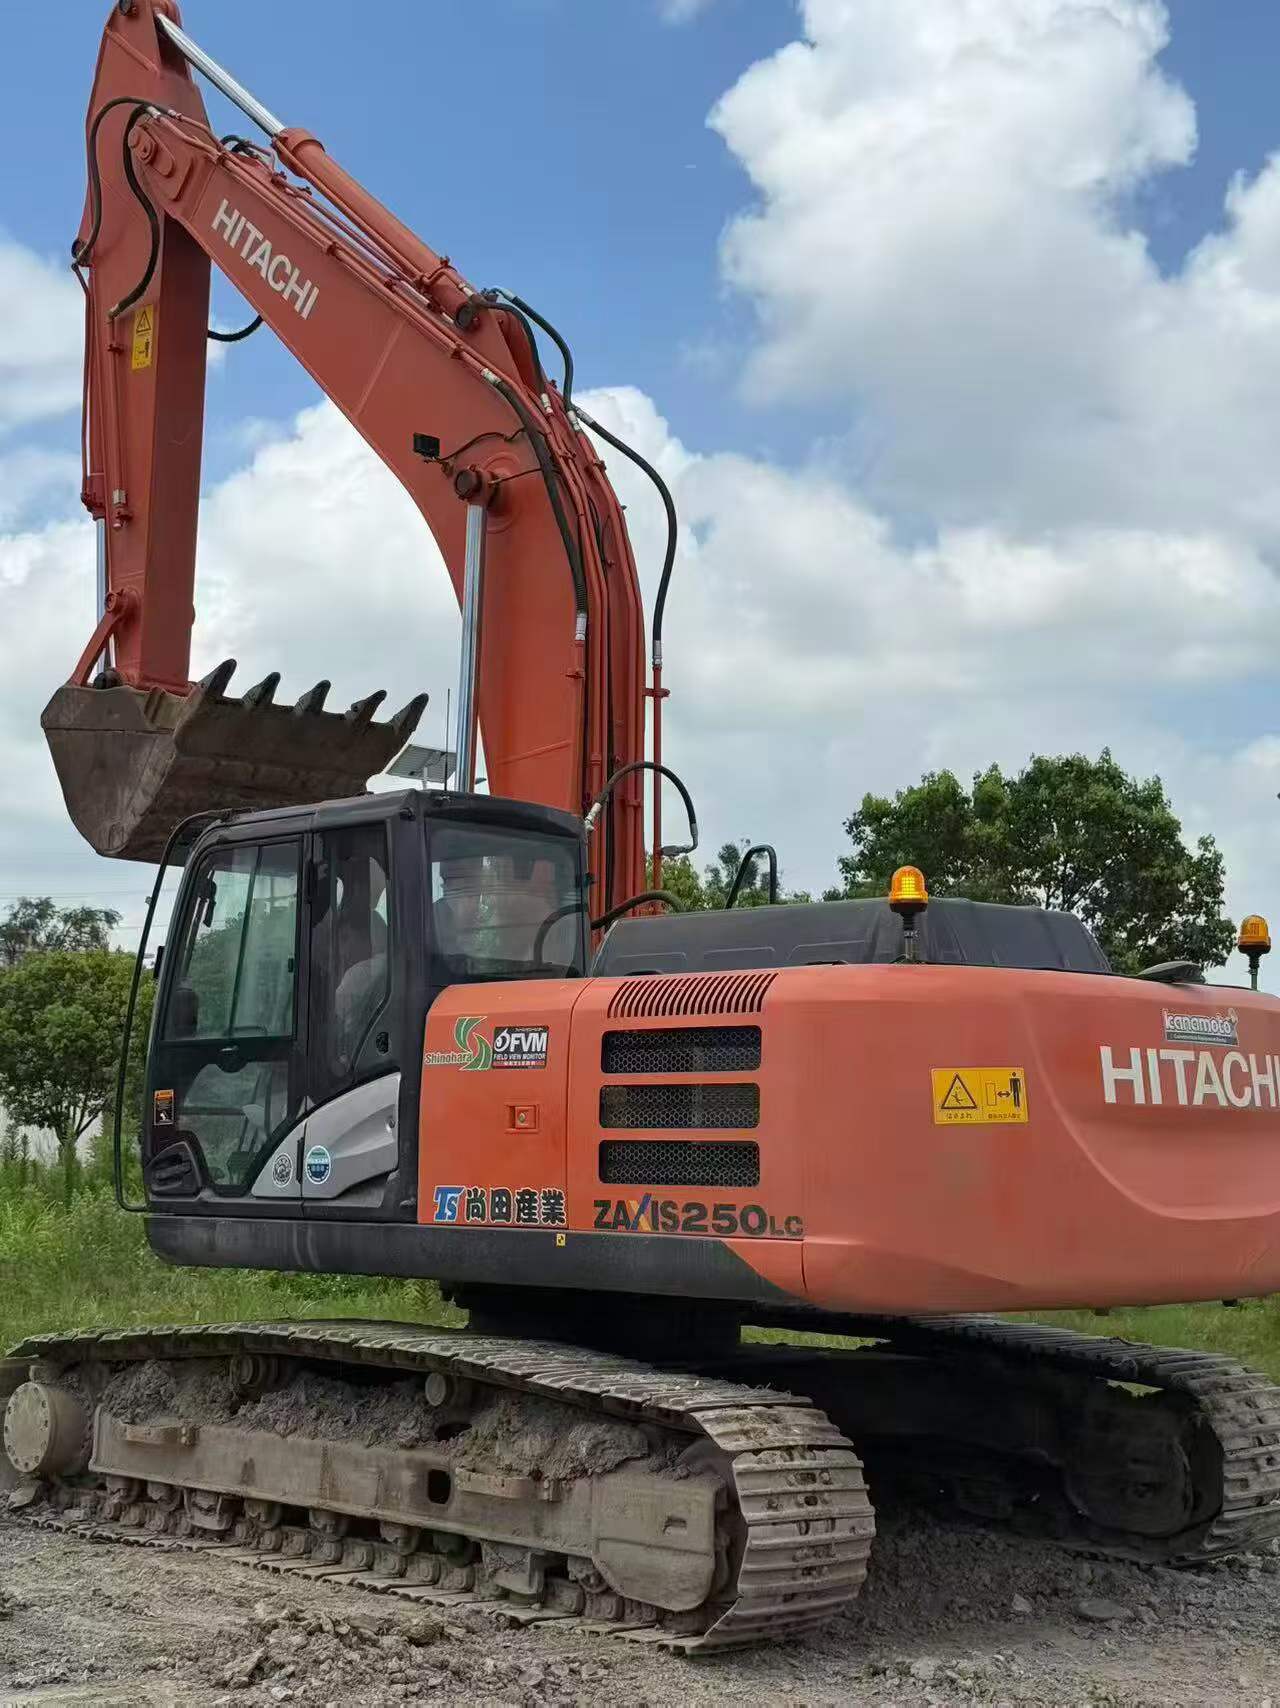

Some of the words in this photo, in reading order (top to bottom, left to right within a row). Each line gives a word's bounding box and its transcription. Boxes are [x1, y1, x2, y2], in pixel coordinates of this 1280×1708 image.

[211, 198, 320, 320] HITACHI
[424, 1051, 473, 1065] Shinohara
[465, 1187, 567, 1226] 尚田産業
